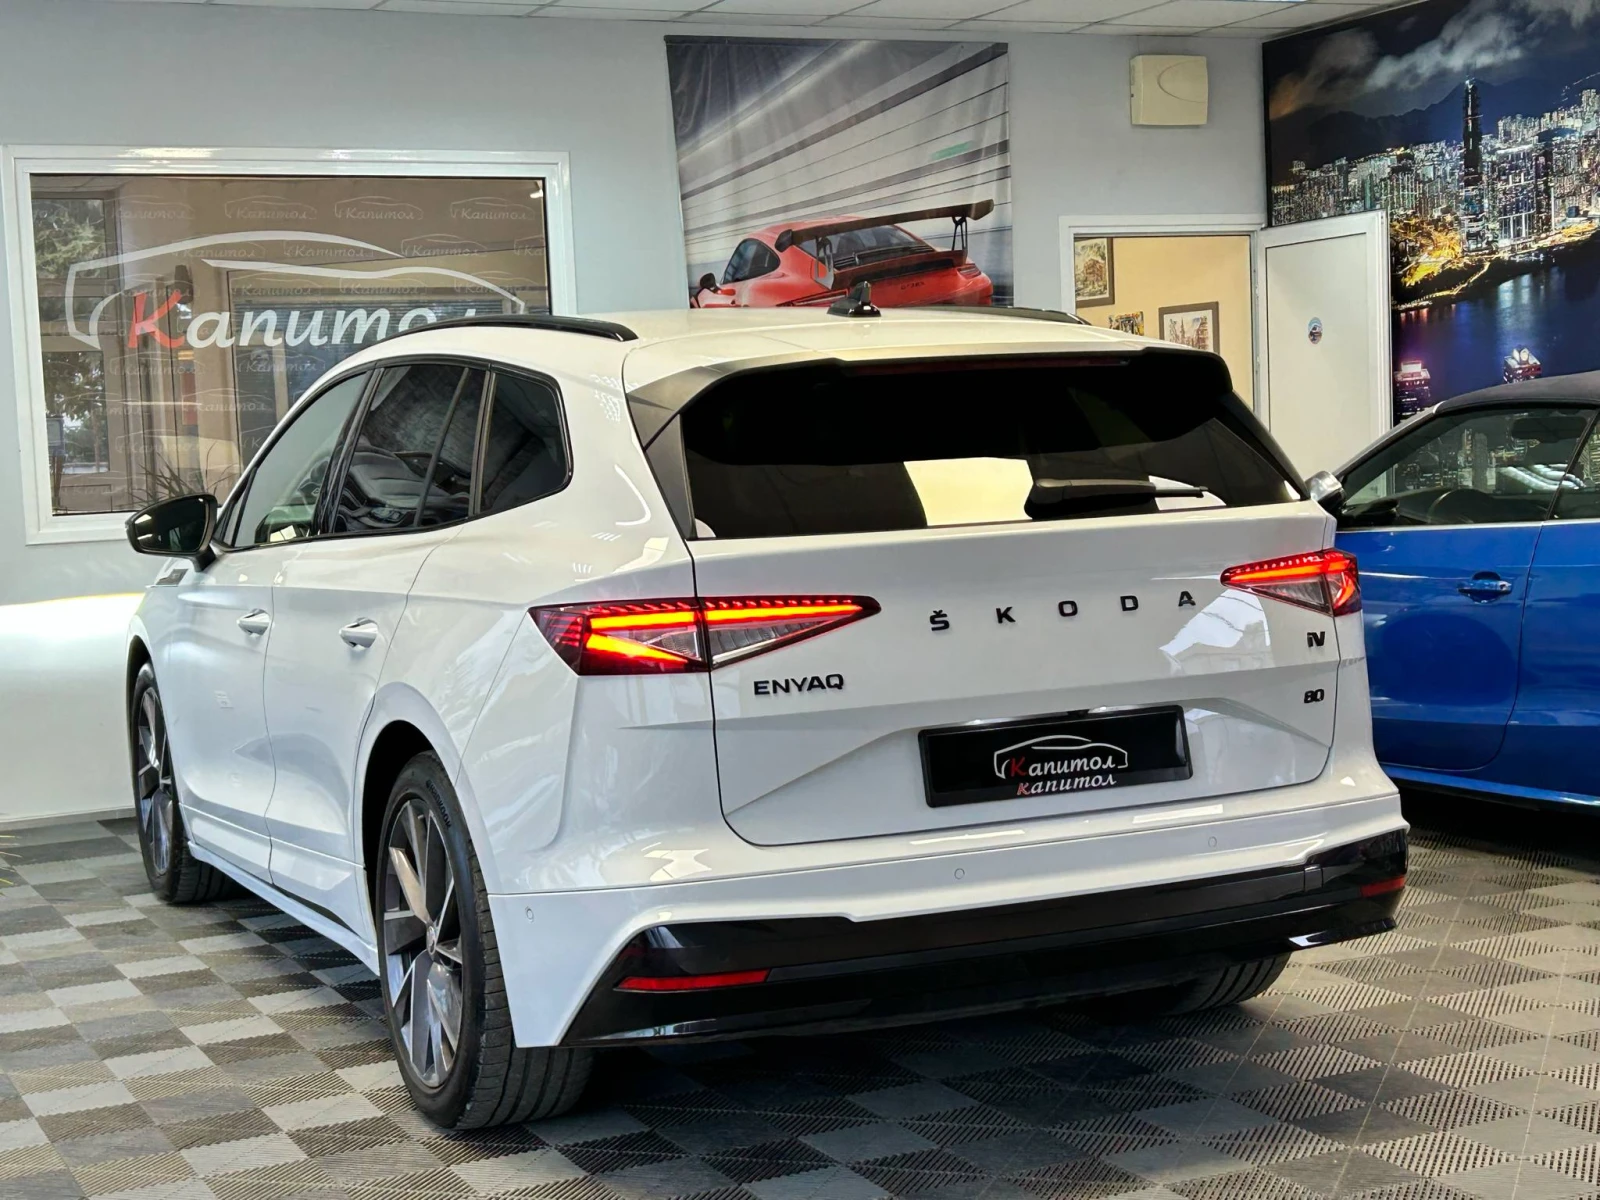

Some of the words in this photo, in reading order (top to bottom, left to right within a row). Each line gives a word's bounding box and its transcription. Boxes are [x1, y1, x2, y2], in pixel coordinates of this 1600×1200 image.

[346, 206, 415, 220] Капитол
[461, 206, 526, 220] Капитол
[128, 290, 476, 348] Капито
[929, 590, 1196, 632] ŠKODA
[753, 673, 844, 696] ENYAQ
[1303, 688, 1325, 704] 80
[1010, 755, 1116, 777] Капитол
